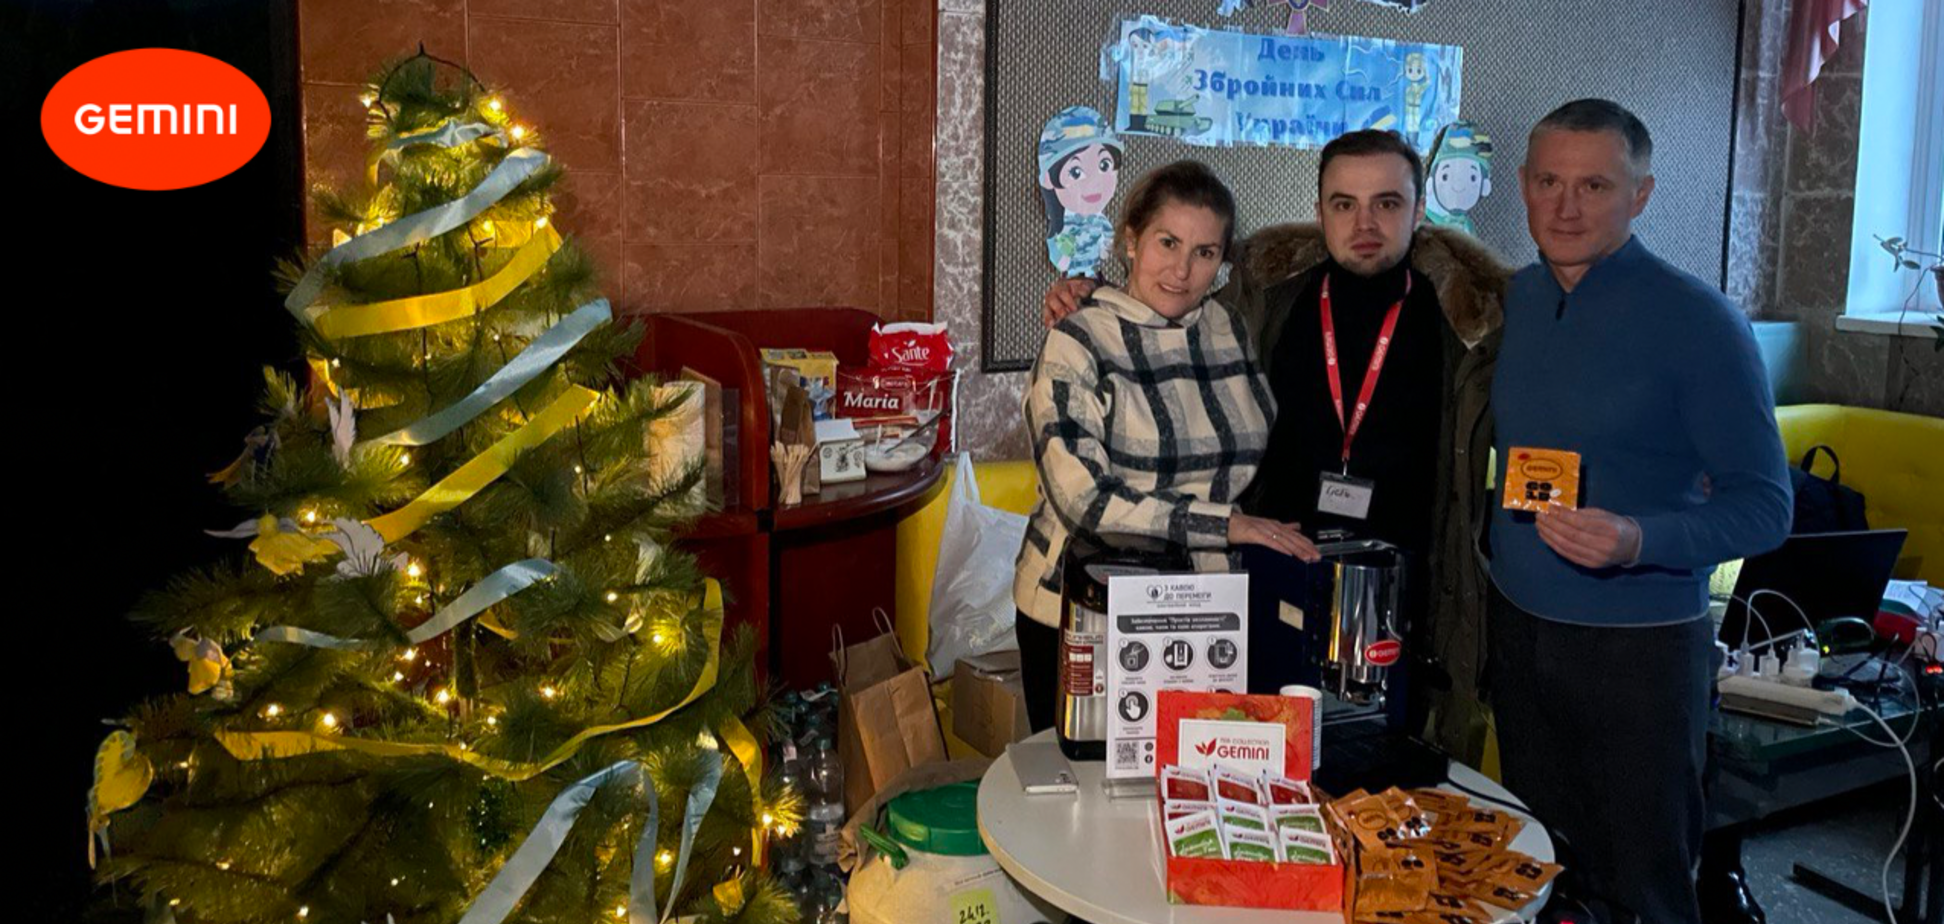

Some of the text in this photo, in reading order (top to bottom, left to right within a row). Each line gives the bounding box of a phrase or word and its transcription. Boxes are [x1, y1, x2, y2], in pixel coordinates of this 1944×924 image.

[1257, 37, 1325, 62] День
[1193, 69, 1381, 102] Збройних Сил
[891, 345, 931, 363] Sante
[844, 391, 900, 410] Maria
[1217, 745, 1270, 761] GEMINI
